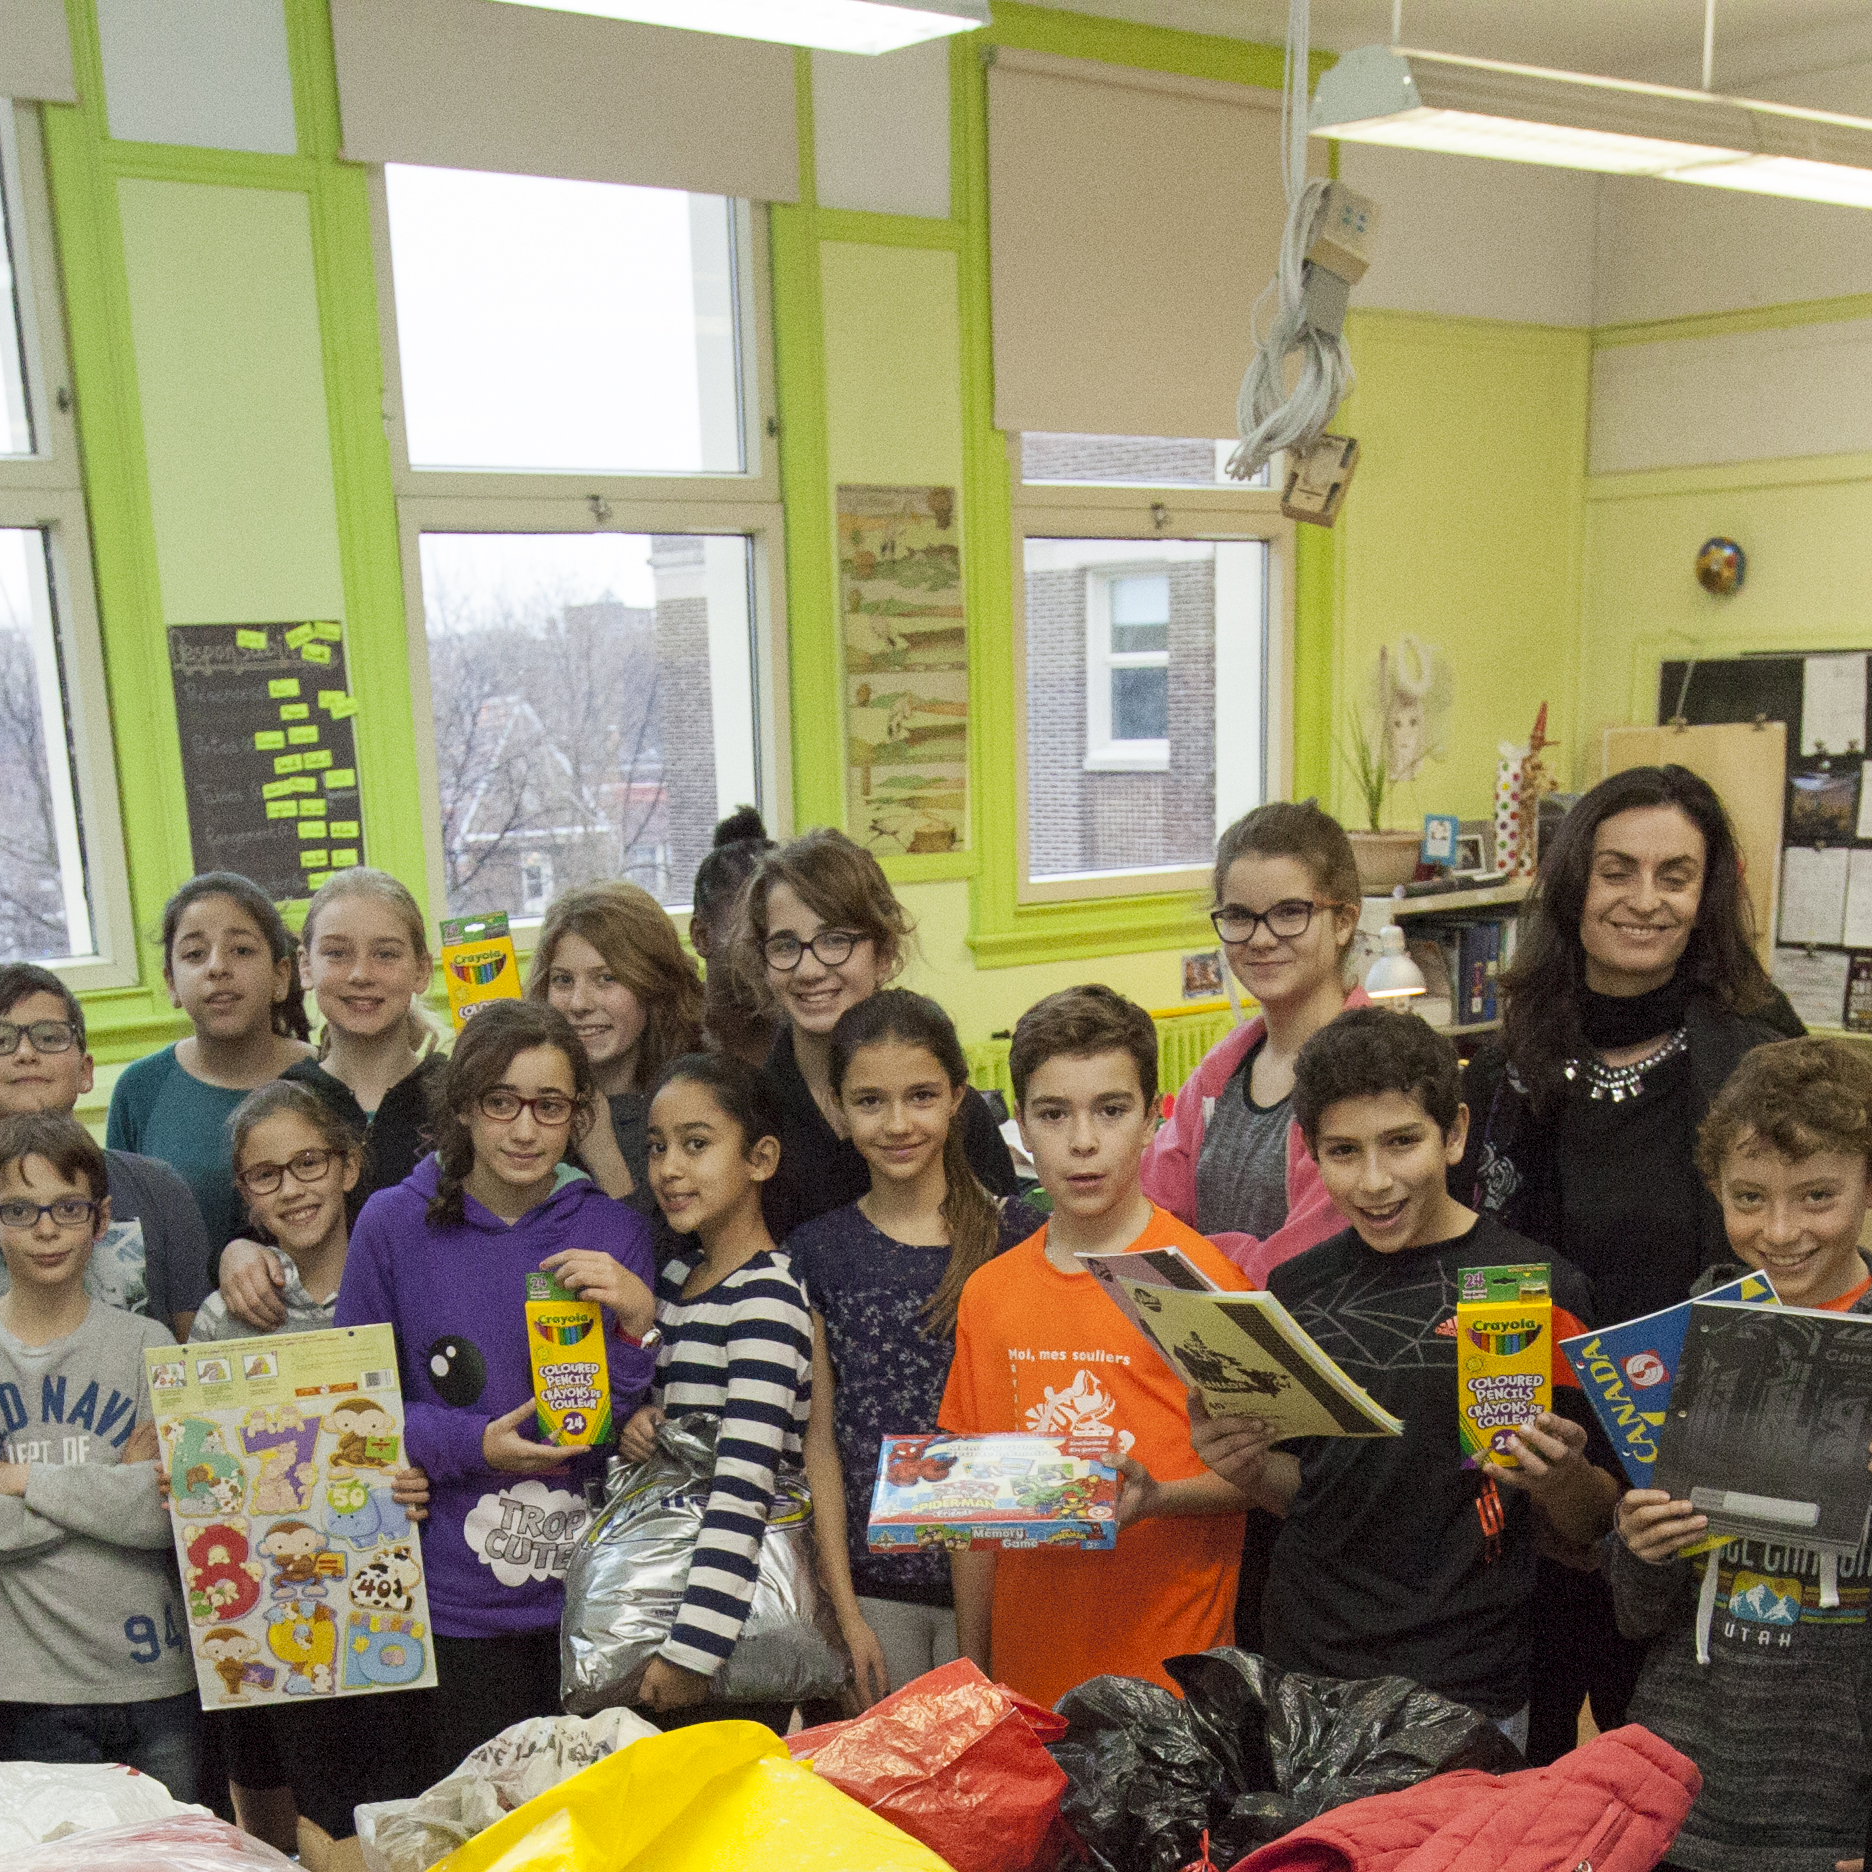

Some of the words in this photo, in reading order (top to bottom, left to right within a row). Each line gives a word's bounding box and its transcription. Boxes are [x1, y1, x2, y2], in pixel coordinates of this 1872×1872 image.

[453, 950, 503, 966] Crayola
[1463, 1271, 1485, 1289] 24
[537, 1312, 590, 1327] Crayola
[1471, 1319, 1536, 1333] Crayola
[1008, 1349, 1036, 1363] Moi,
[1039, 1350, 1068, 1361] mes
[1072, 1350, 1132, 1366] souliers
[539, 1362, 600, 1378] COLOURED
[546, 1374, 593, 1388] PENCILS
[1468, 1374, 1544, 1392] COLOURED
[540, 1387, 588, 1401] CRAYONS
[1475, 1387, 1534, 1401] PENCILS
[1581, 1337, 1659, 1464] CANADA
[550, 1398, 597, 1411] COULEUR
[1468, 1401, 1527, 1418] CRAYONS
[565, 1416, 585, 1431] 24
[330, 1487, 367, 1509] 50
[497, 1497, 586, 1541] TROP
[971, 1527, 1025, 1540] Memory
[1001, 1538, 1040, 1549] Game
[357, 1578, 392, 1601] 40
[1724, 1622, 1792, 1648] UTAH
